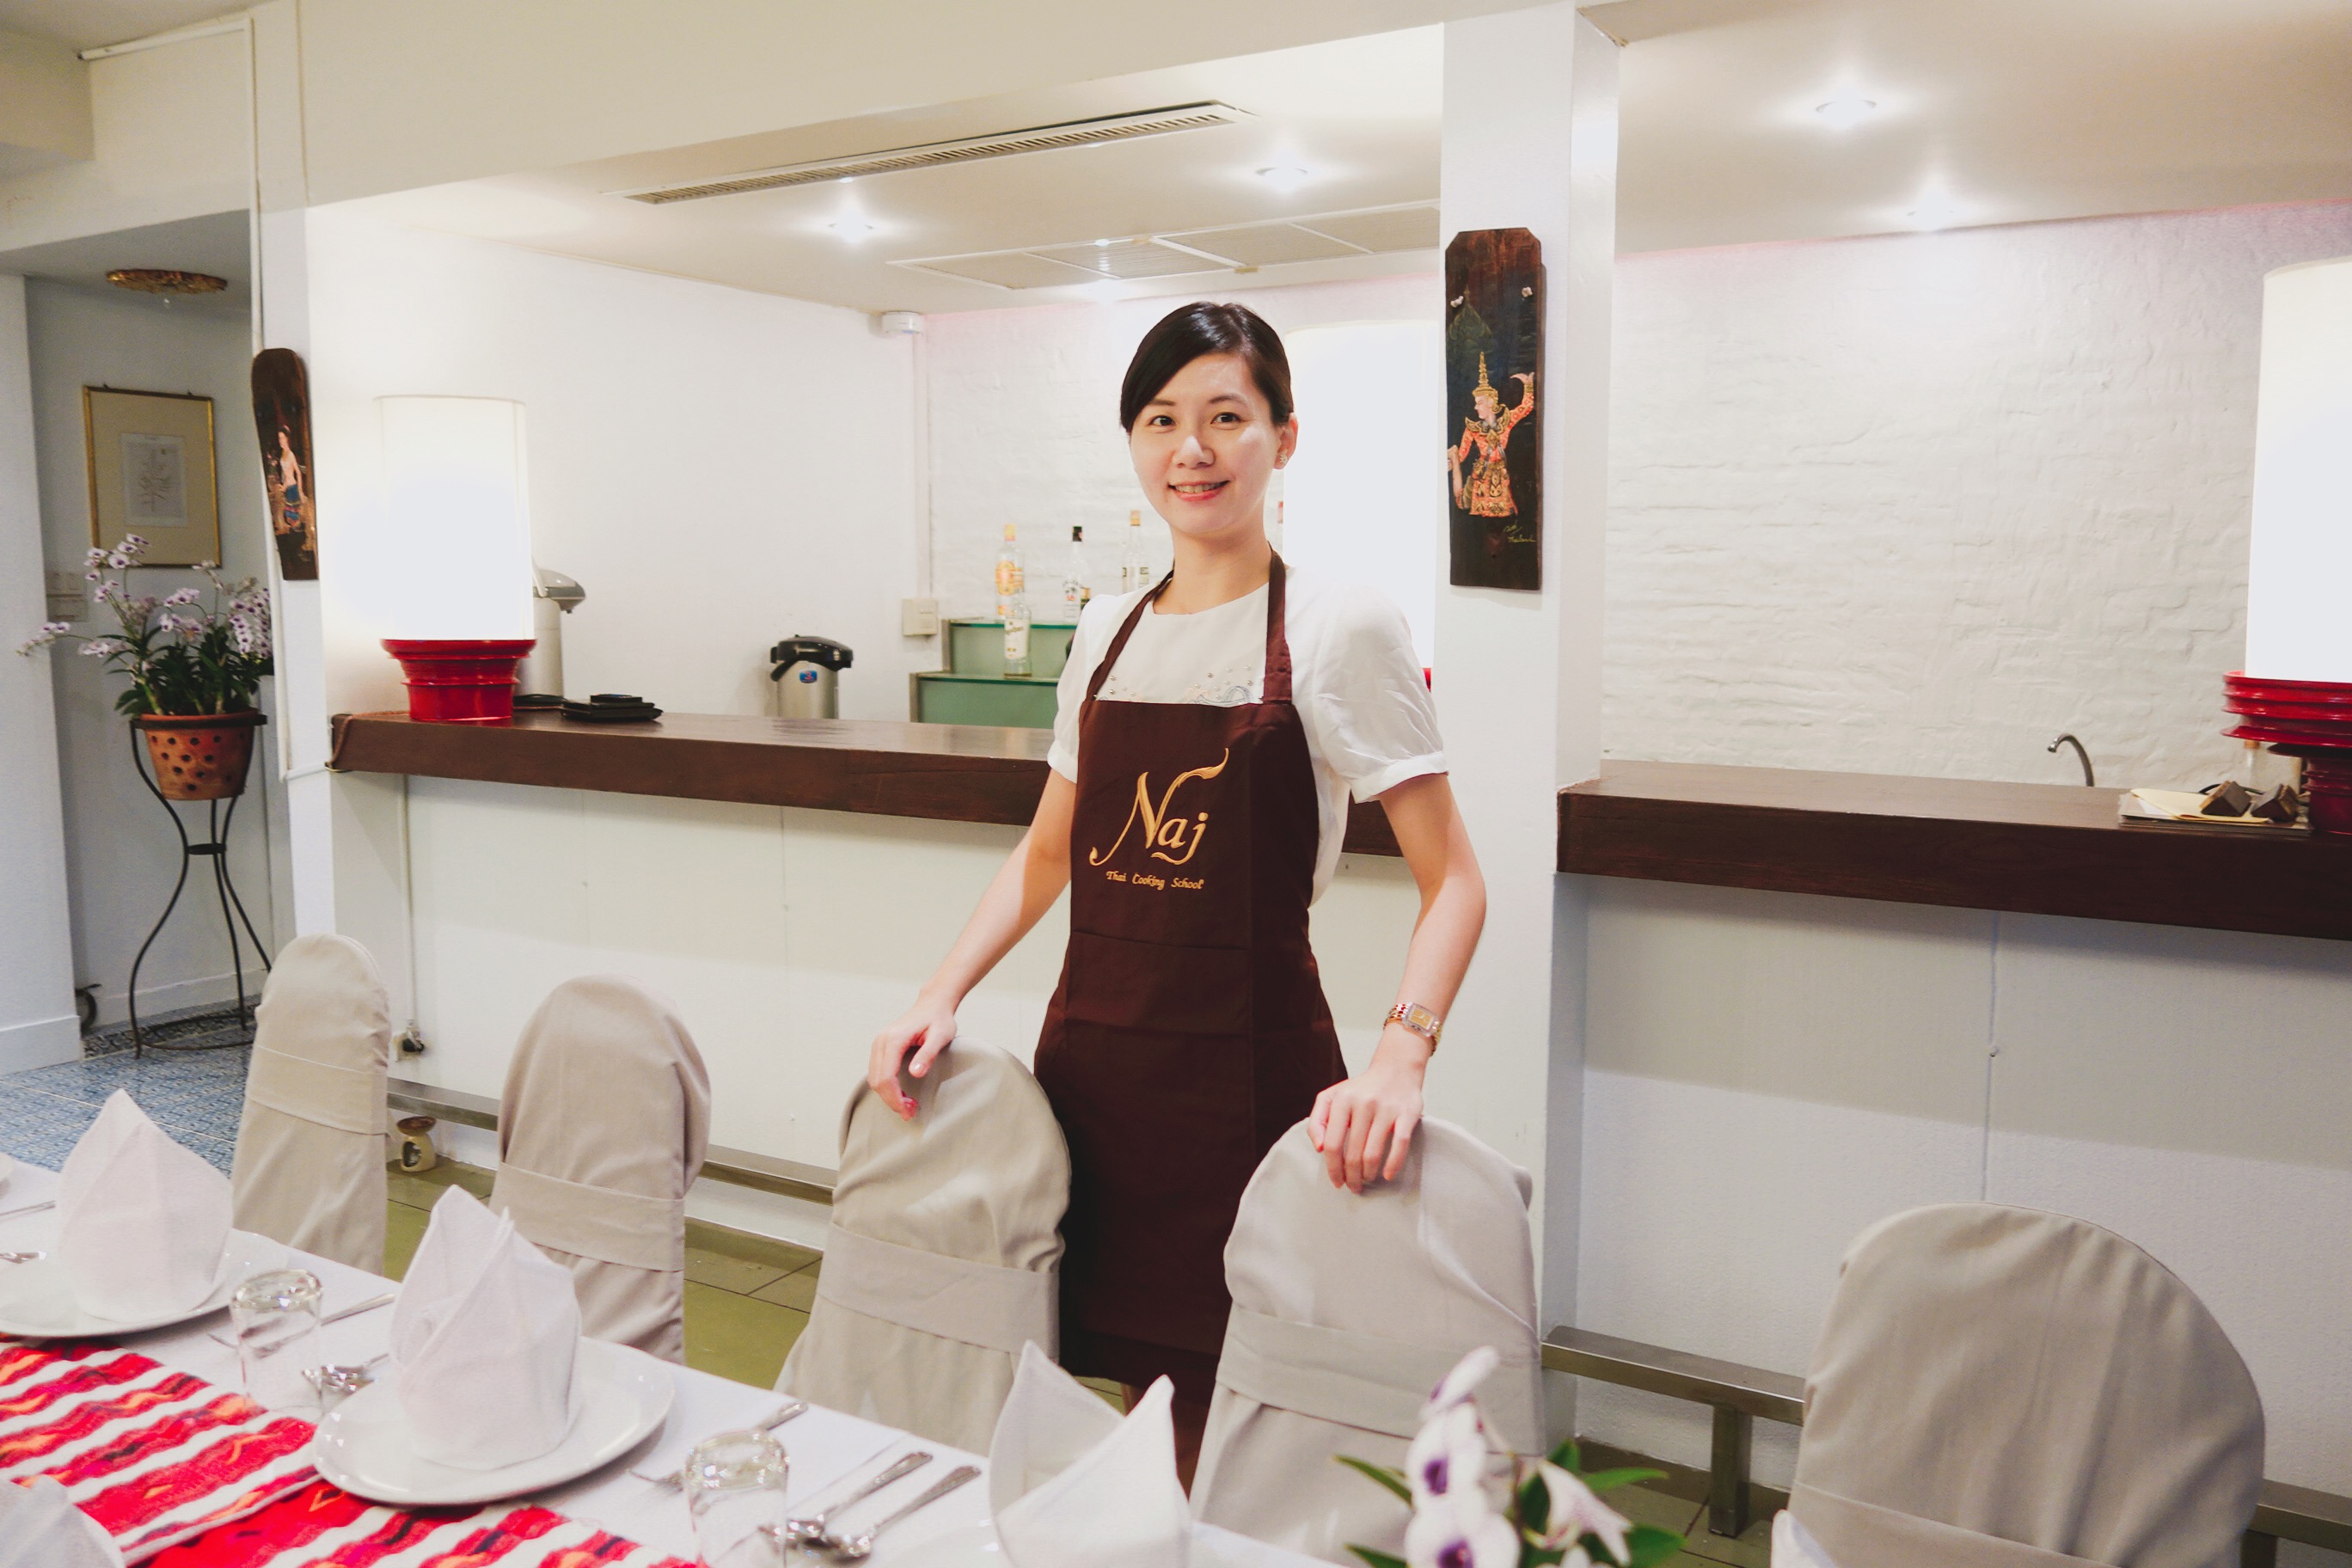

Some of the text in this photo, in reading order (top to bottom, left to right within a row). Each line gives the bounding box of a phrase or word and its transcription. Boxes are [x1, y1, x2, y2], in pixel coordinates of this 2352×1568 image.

[1089, 748, 1229, 866] Naj
[1106, 871, 1204, 891] Thai Cooking School
